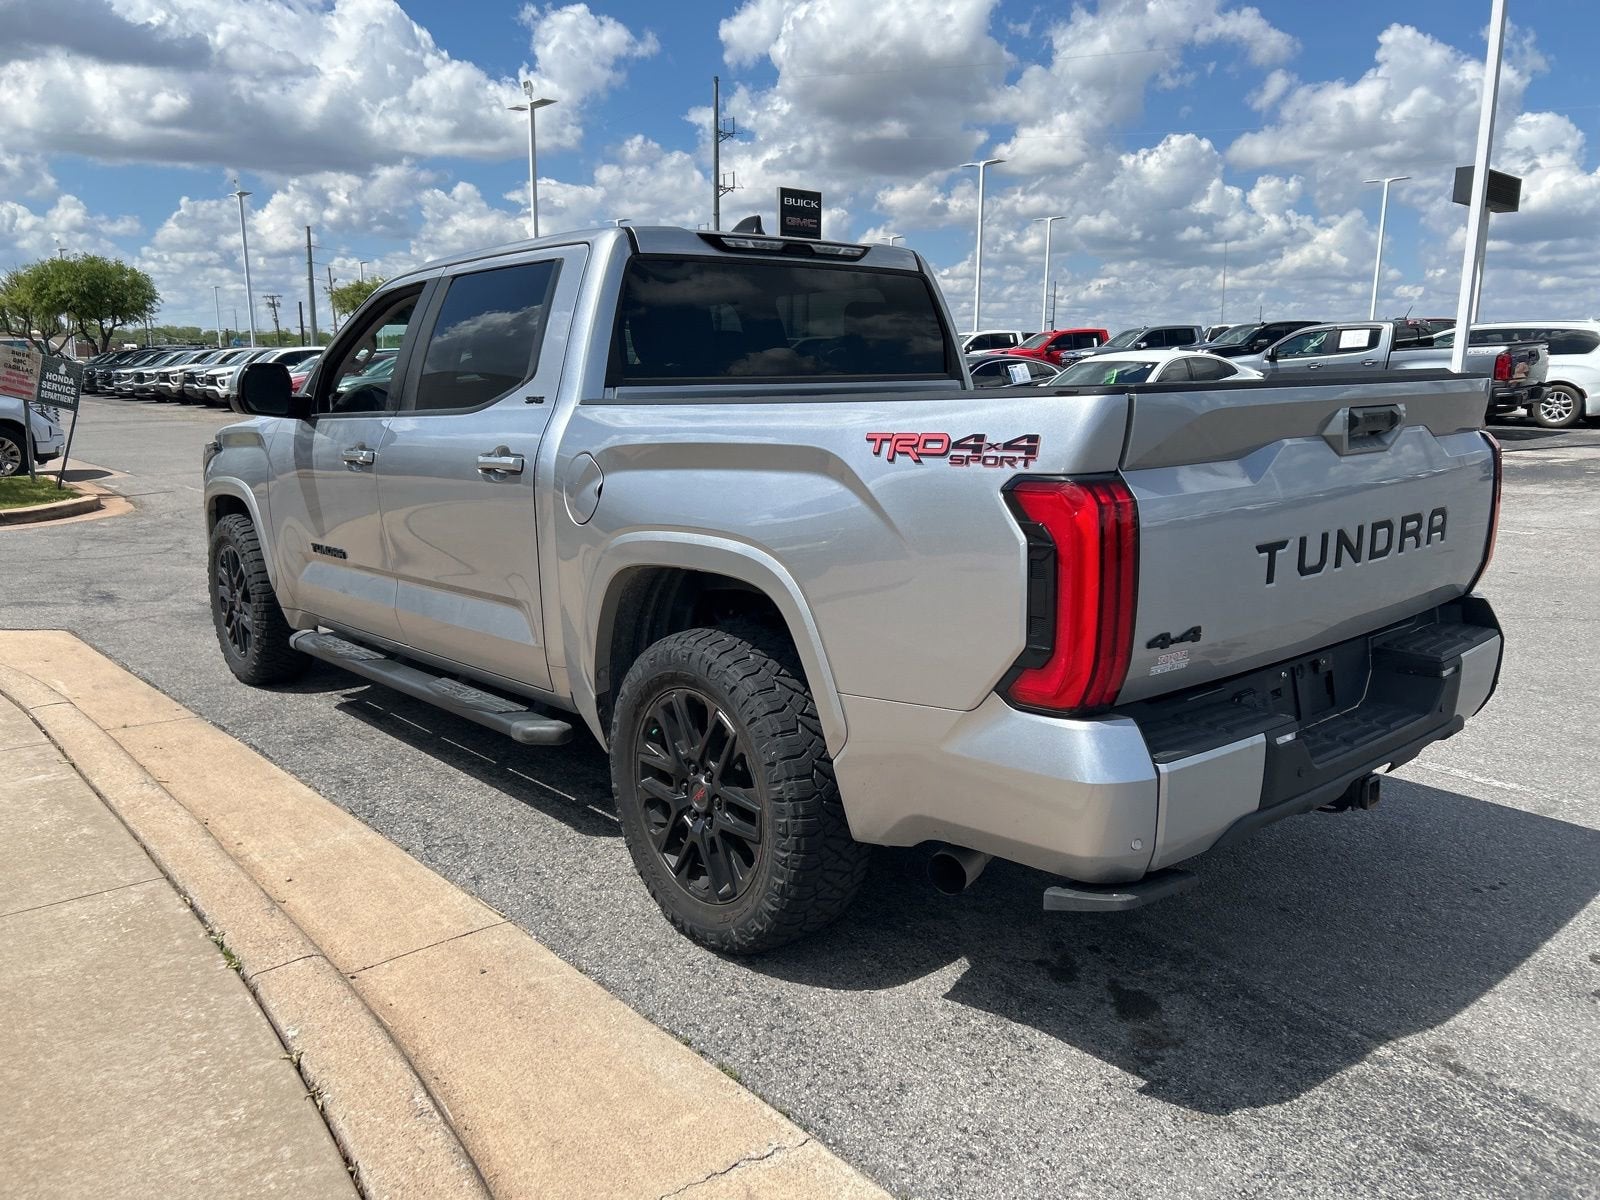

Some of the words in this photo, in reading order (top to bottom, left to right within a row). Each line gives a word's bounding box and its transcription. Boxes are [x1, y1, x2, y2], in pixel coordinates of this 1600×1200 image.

[784, 197, 819, 209] BUICK
[785, 216, 818, 228] GMC
[3, 362, 34, 374] CADILLAC
[45, 372, 74, 385] HONDA
[41, 380, 77, 395] SERVICE
[40, 390, 75, 404] DEPARTMENT
[865, 432, 951, 465] TRD
[948, 454, 1037, 470] SPORT
[1255, 505, 1449, 588] TUNDRA
